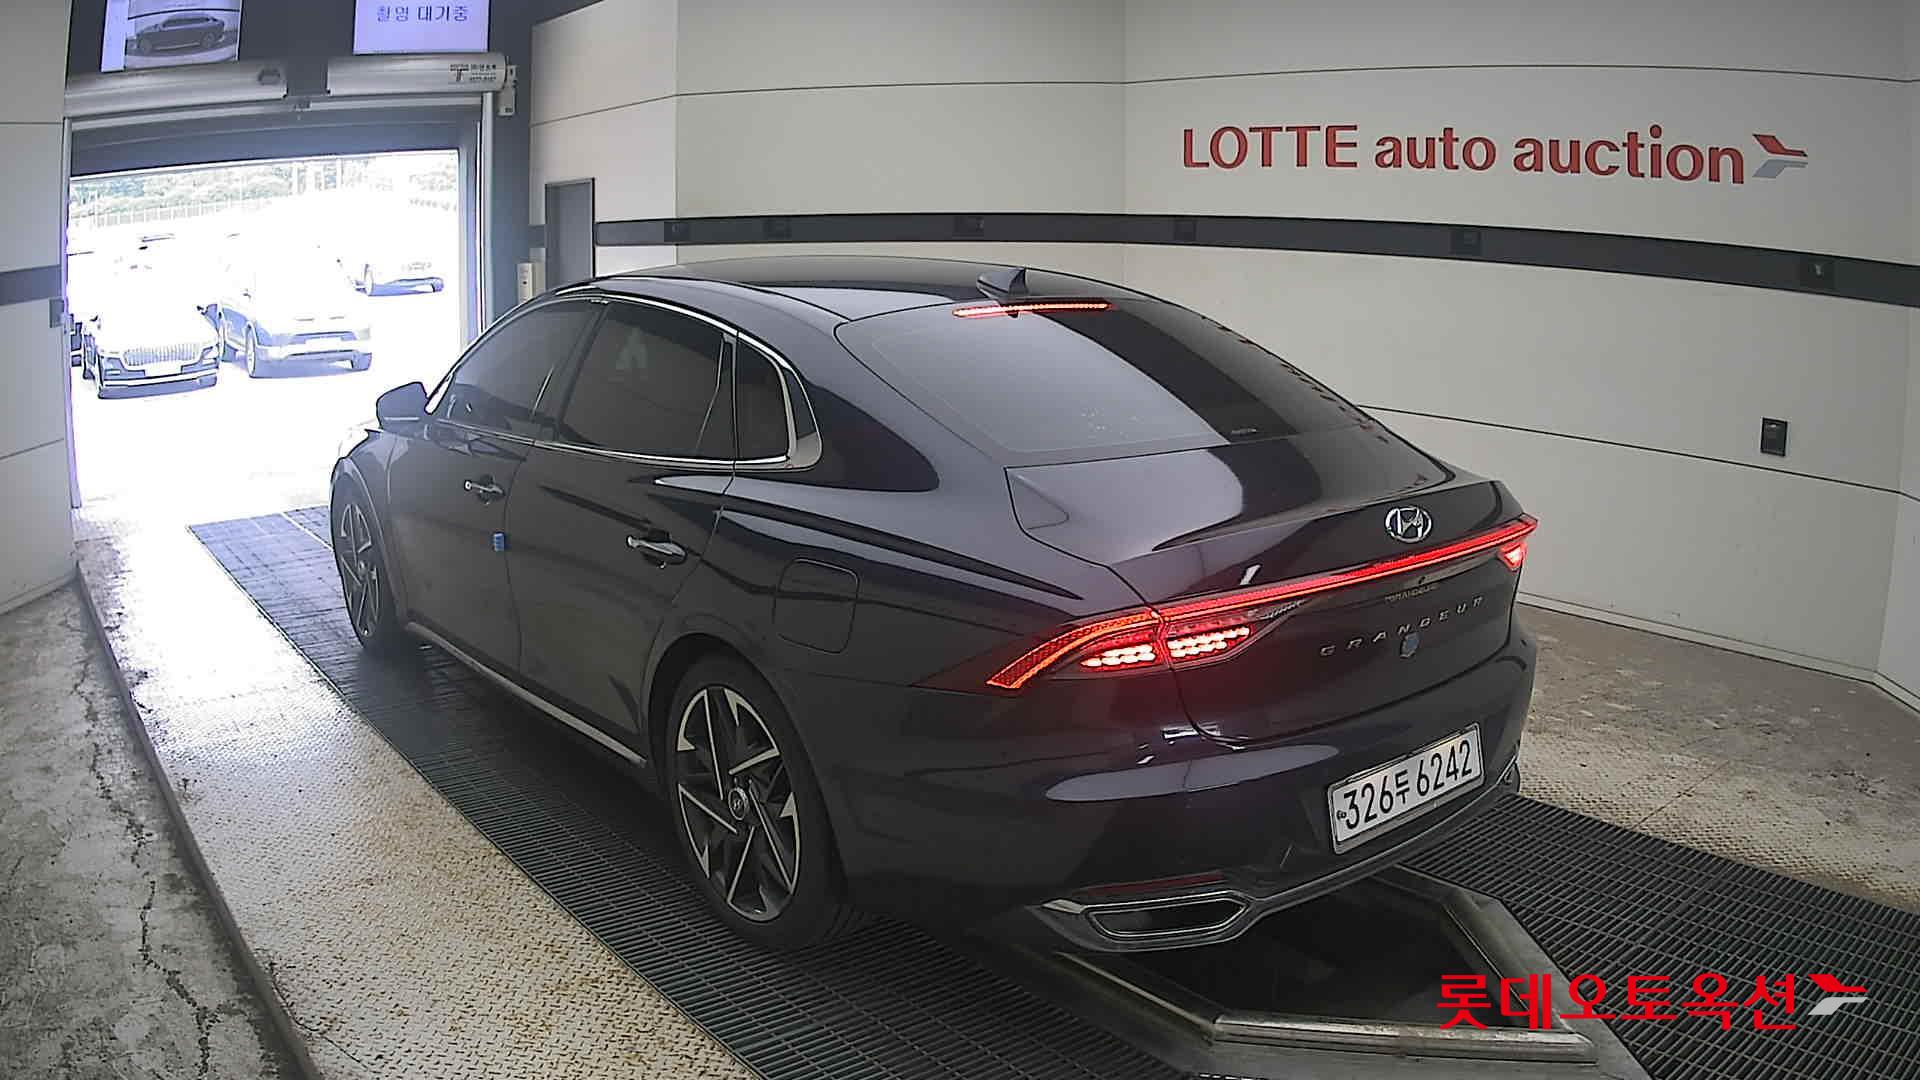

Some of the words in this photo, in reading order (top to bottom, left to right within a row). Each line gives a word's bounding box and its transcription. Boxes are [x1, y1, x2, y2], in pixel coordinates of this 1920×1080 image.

[417, 5, 468, 22] 대기중
[1183, 125, 1358, 169] LOTTE
[1375, 127, 1497, 171] auto
[1513, 124, 1745, 184] auction
[1319, 596, 1483, 657] GRANDEUR
